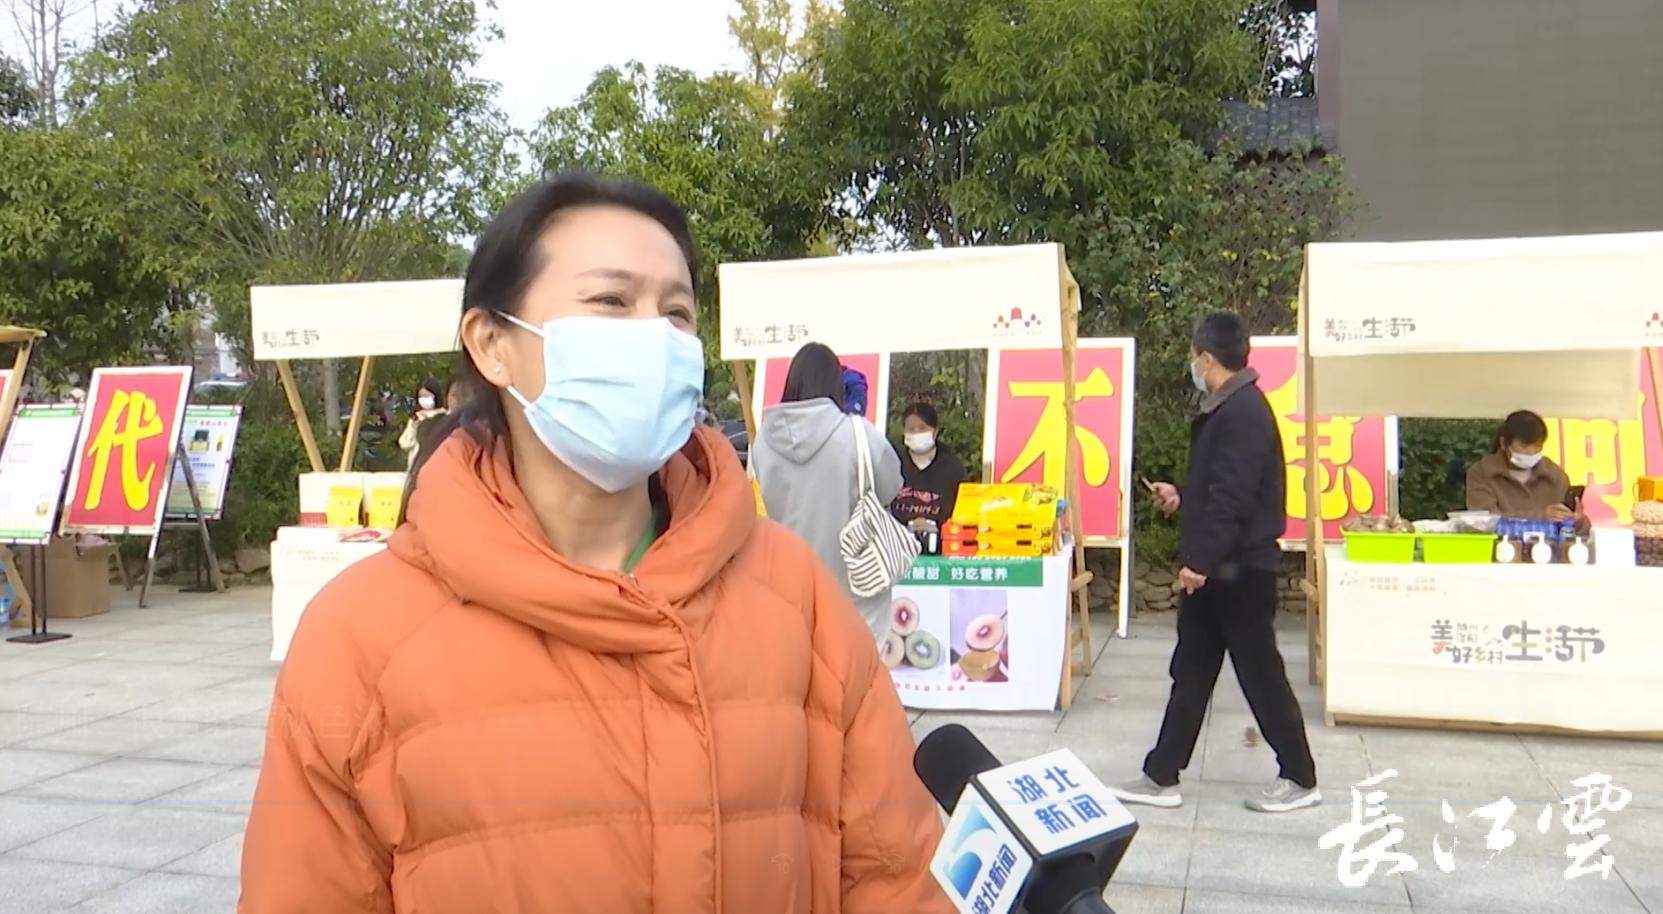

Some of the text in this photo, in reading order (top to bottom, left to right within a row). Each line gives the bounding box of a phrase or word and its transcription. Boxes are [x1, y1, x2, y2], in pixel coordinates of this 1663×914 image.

[1002, 366, 1114, 489] 不
[85, 389, 163, 511] 代
[951, 566, 1009, 581] 好吃营养
[1007, 766, 1080, 804] 湖北
[1034, 793, 1107, 834] 新闻
